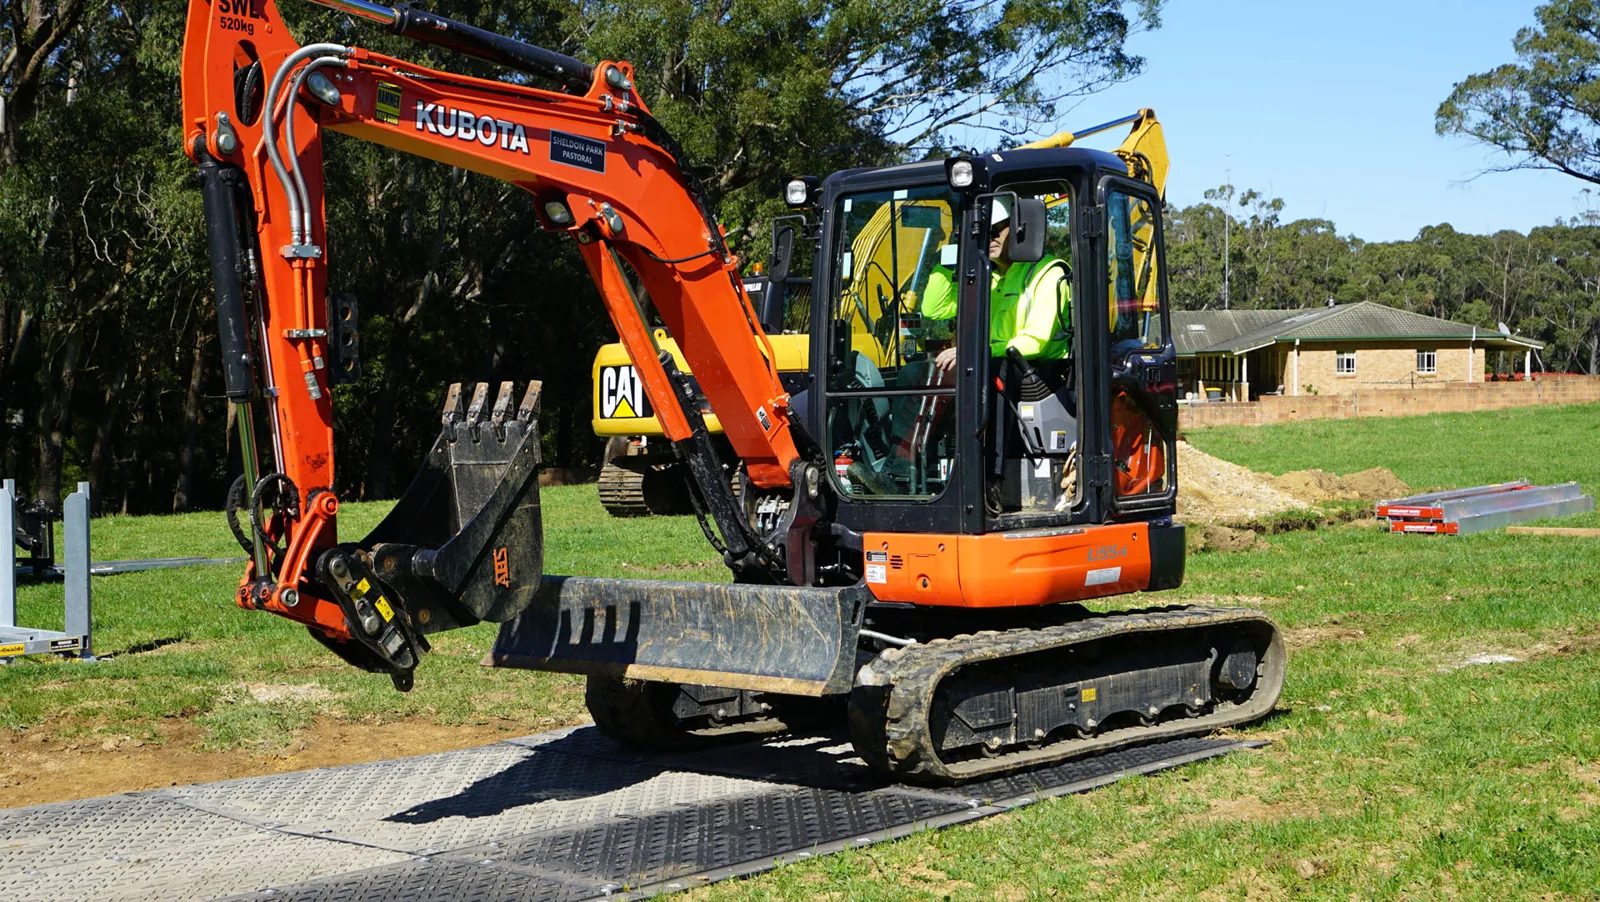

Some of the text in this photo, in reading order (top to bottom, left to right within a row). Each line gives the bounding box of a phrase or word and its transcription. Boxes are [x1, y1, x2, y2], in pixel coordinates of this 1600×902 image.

[219, 0, 260, 19] SWL
[220, 16, 254, 36] 520kg
[415, 100, 530, 155] KUBOTA
[553, 136, 603, 157] SHELDON PARK
[562, 150, 593, 165] PASTORAL
[603, 366, 643, 418] CAT
